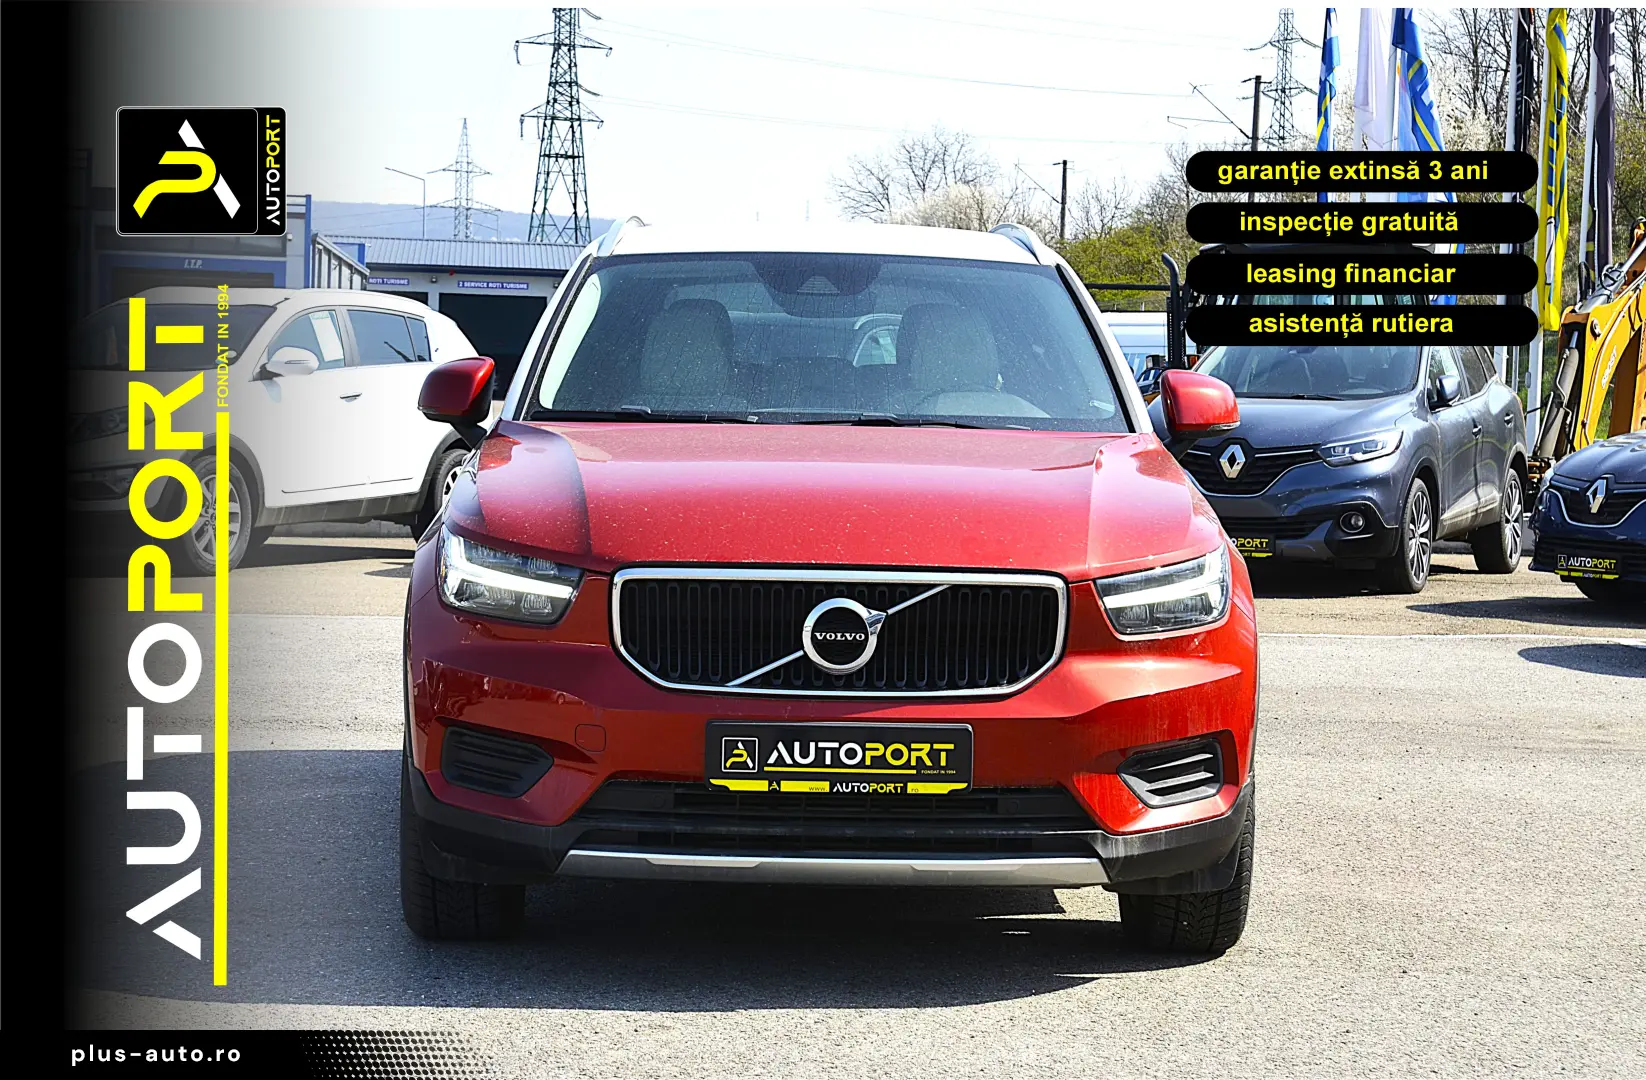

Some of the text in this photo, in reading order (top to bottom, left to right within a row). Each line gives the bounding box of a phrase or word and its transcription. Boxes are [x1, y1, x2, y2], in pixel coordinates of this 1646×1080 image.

[1230, 537, 1269, 548] OPORT
[1568, 556, 1616, 569] AUTOPORT
[813, 631, 866, 642] VOLVO
[766, 741, 955, 767] AUTOPORT
[833, 783, 904, 793] AUTOPORT
